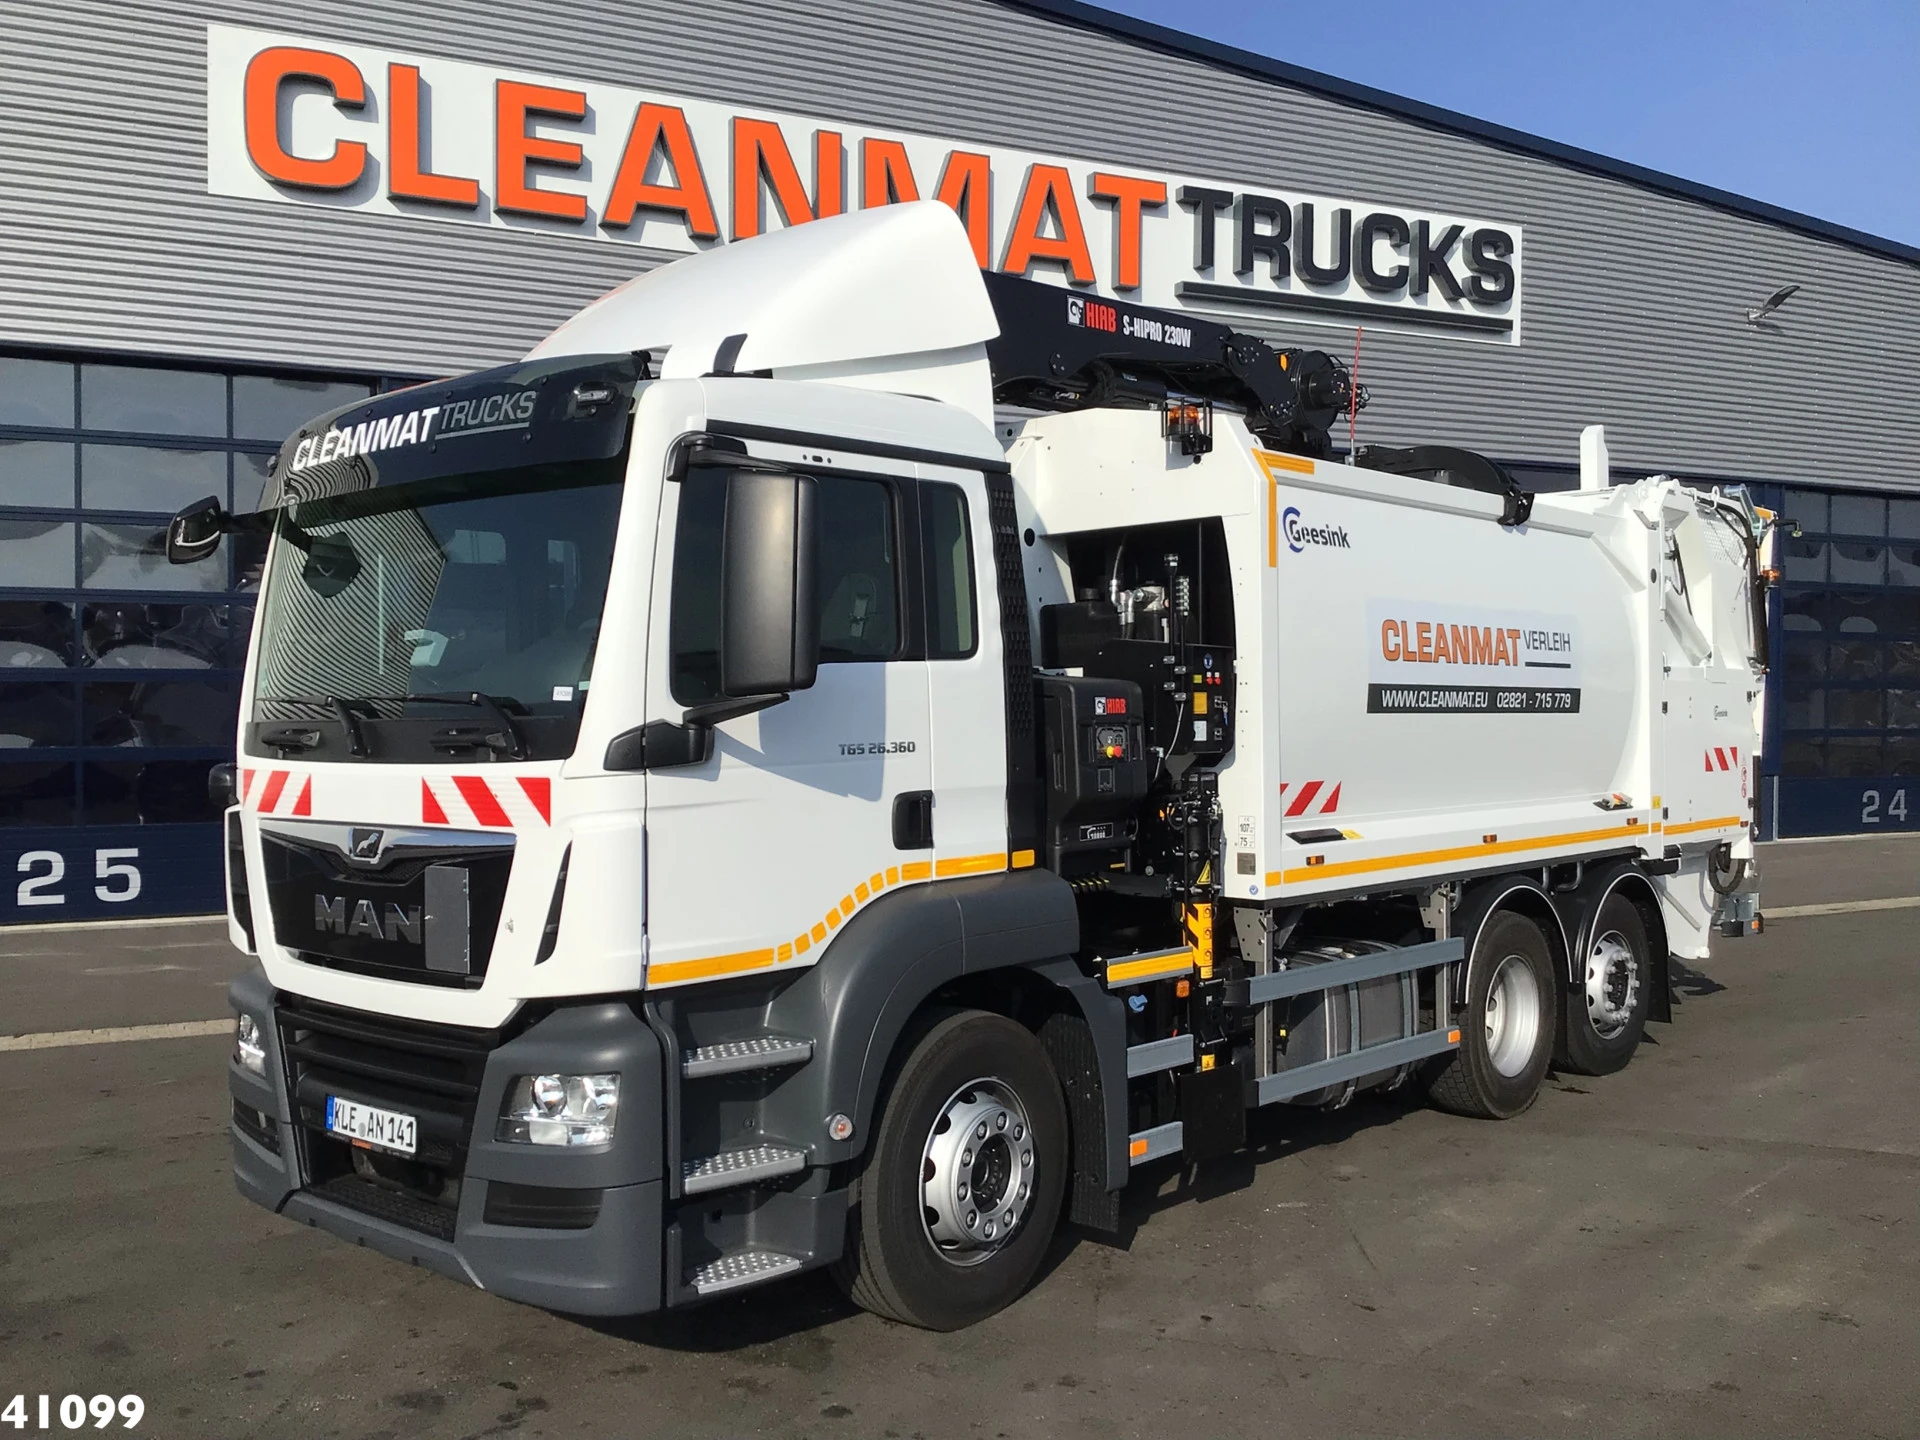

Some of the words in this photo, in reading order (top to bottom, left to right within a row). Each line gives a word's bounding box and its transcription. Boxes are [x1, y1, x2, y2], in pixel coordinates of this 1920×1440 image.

[243, 45, 1168, 291] CLEANMAT
[1176, 184, 1515, 304] TRUCKS
[1085, 301, 1117, 333] HIAB
[1122, 314, 1162, 342] S-HIPRO
[1164, 324, 1192, 348] 230W
[293, 406, 440, 471] CLEANMAT
[440, 390, 537, 430] TRUCKS
[1288, 517, 1351, 549] Geesink
[1381, 618, 1521, 667] CLEANMAT
[1523, 629, 1572, 653] VERLEIH
[1106, 698, 1127, 714] HIAB
[1382, 689, 1489, 708] WWW.CLEANMAT.EU
[1496, 692, 1527, 708] 02821
[1535, 693, 1552, 708] 715
[1554, 693, 1572, 709] 779
[868, 741, 916, 754] 26.360
[1862, 789, 1908, 823] 24
[315, 893, 422, 945] MAN
[334, 1102, 357, 1133] KLE
[367, 1111, 384, 1141] AN
[388, 1116, 414, 1148] 141
